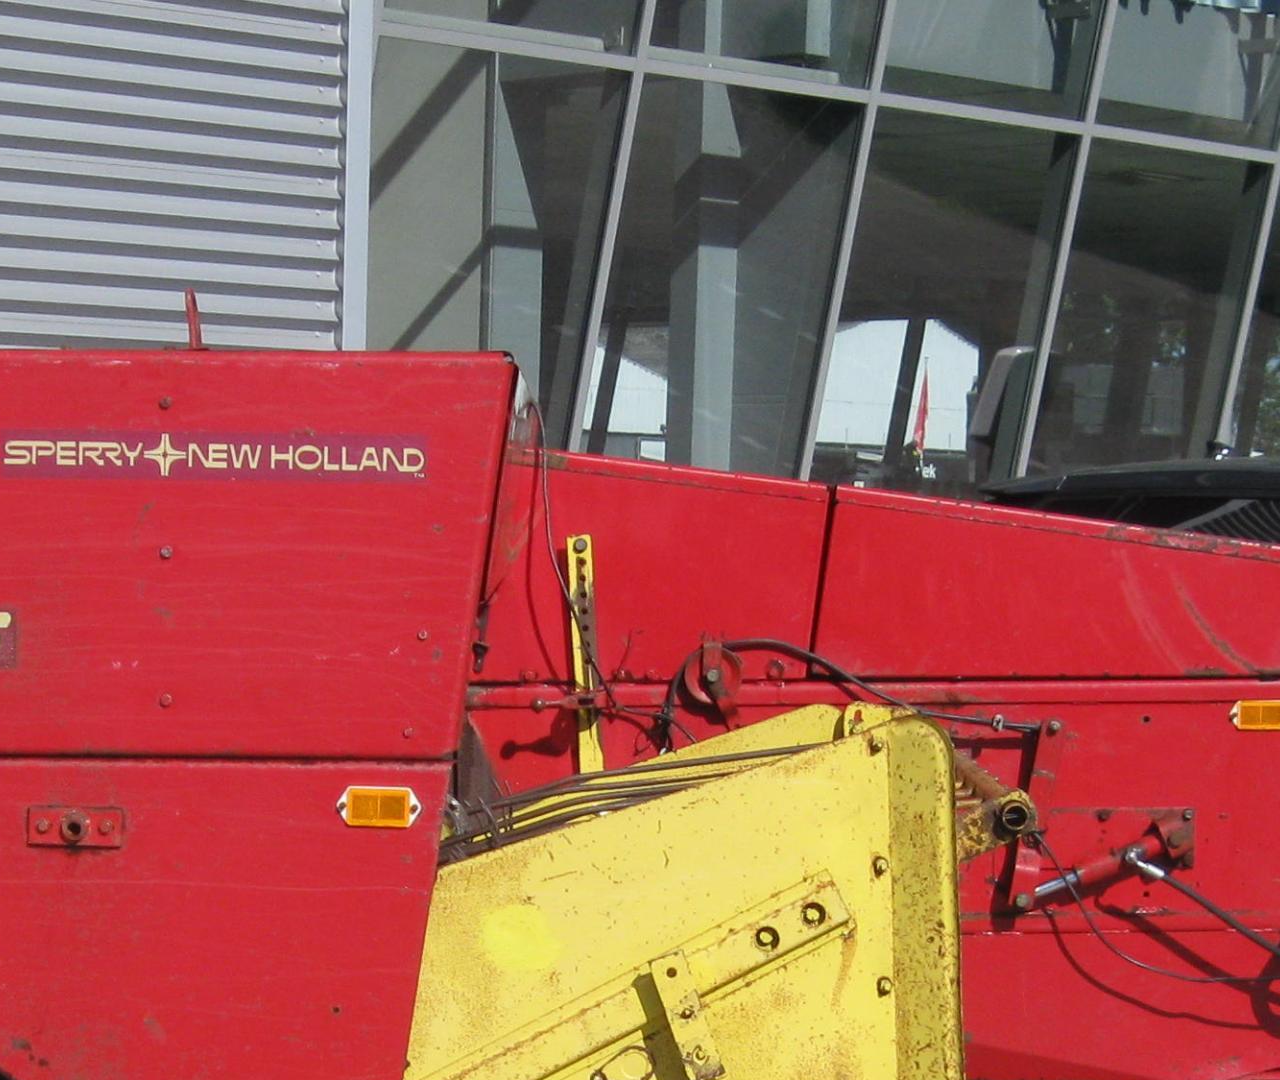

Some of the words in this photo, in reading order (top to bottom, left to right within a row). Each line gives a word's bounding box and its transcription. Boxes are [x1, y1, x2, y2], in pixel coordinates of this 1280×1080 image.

[2, 440, 144, 467] SPERRY
[186, 443, 262, 470] NEW
[271, 444, 425, 473] HOLLAND
